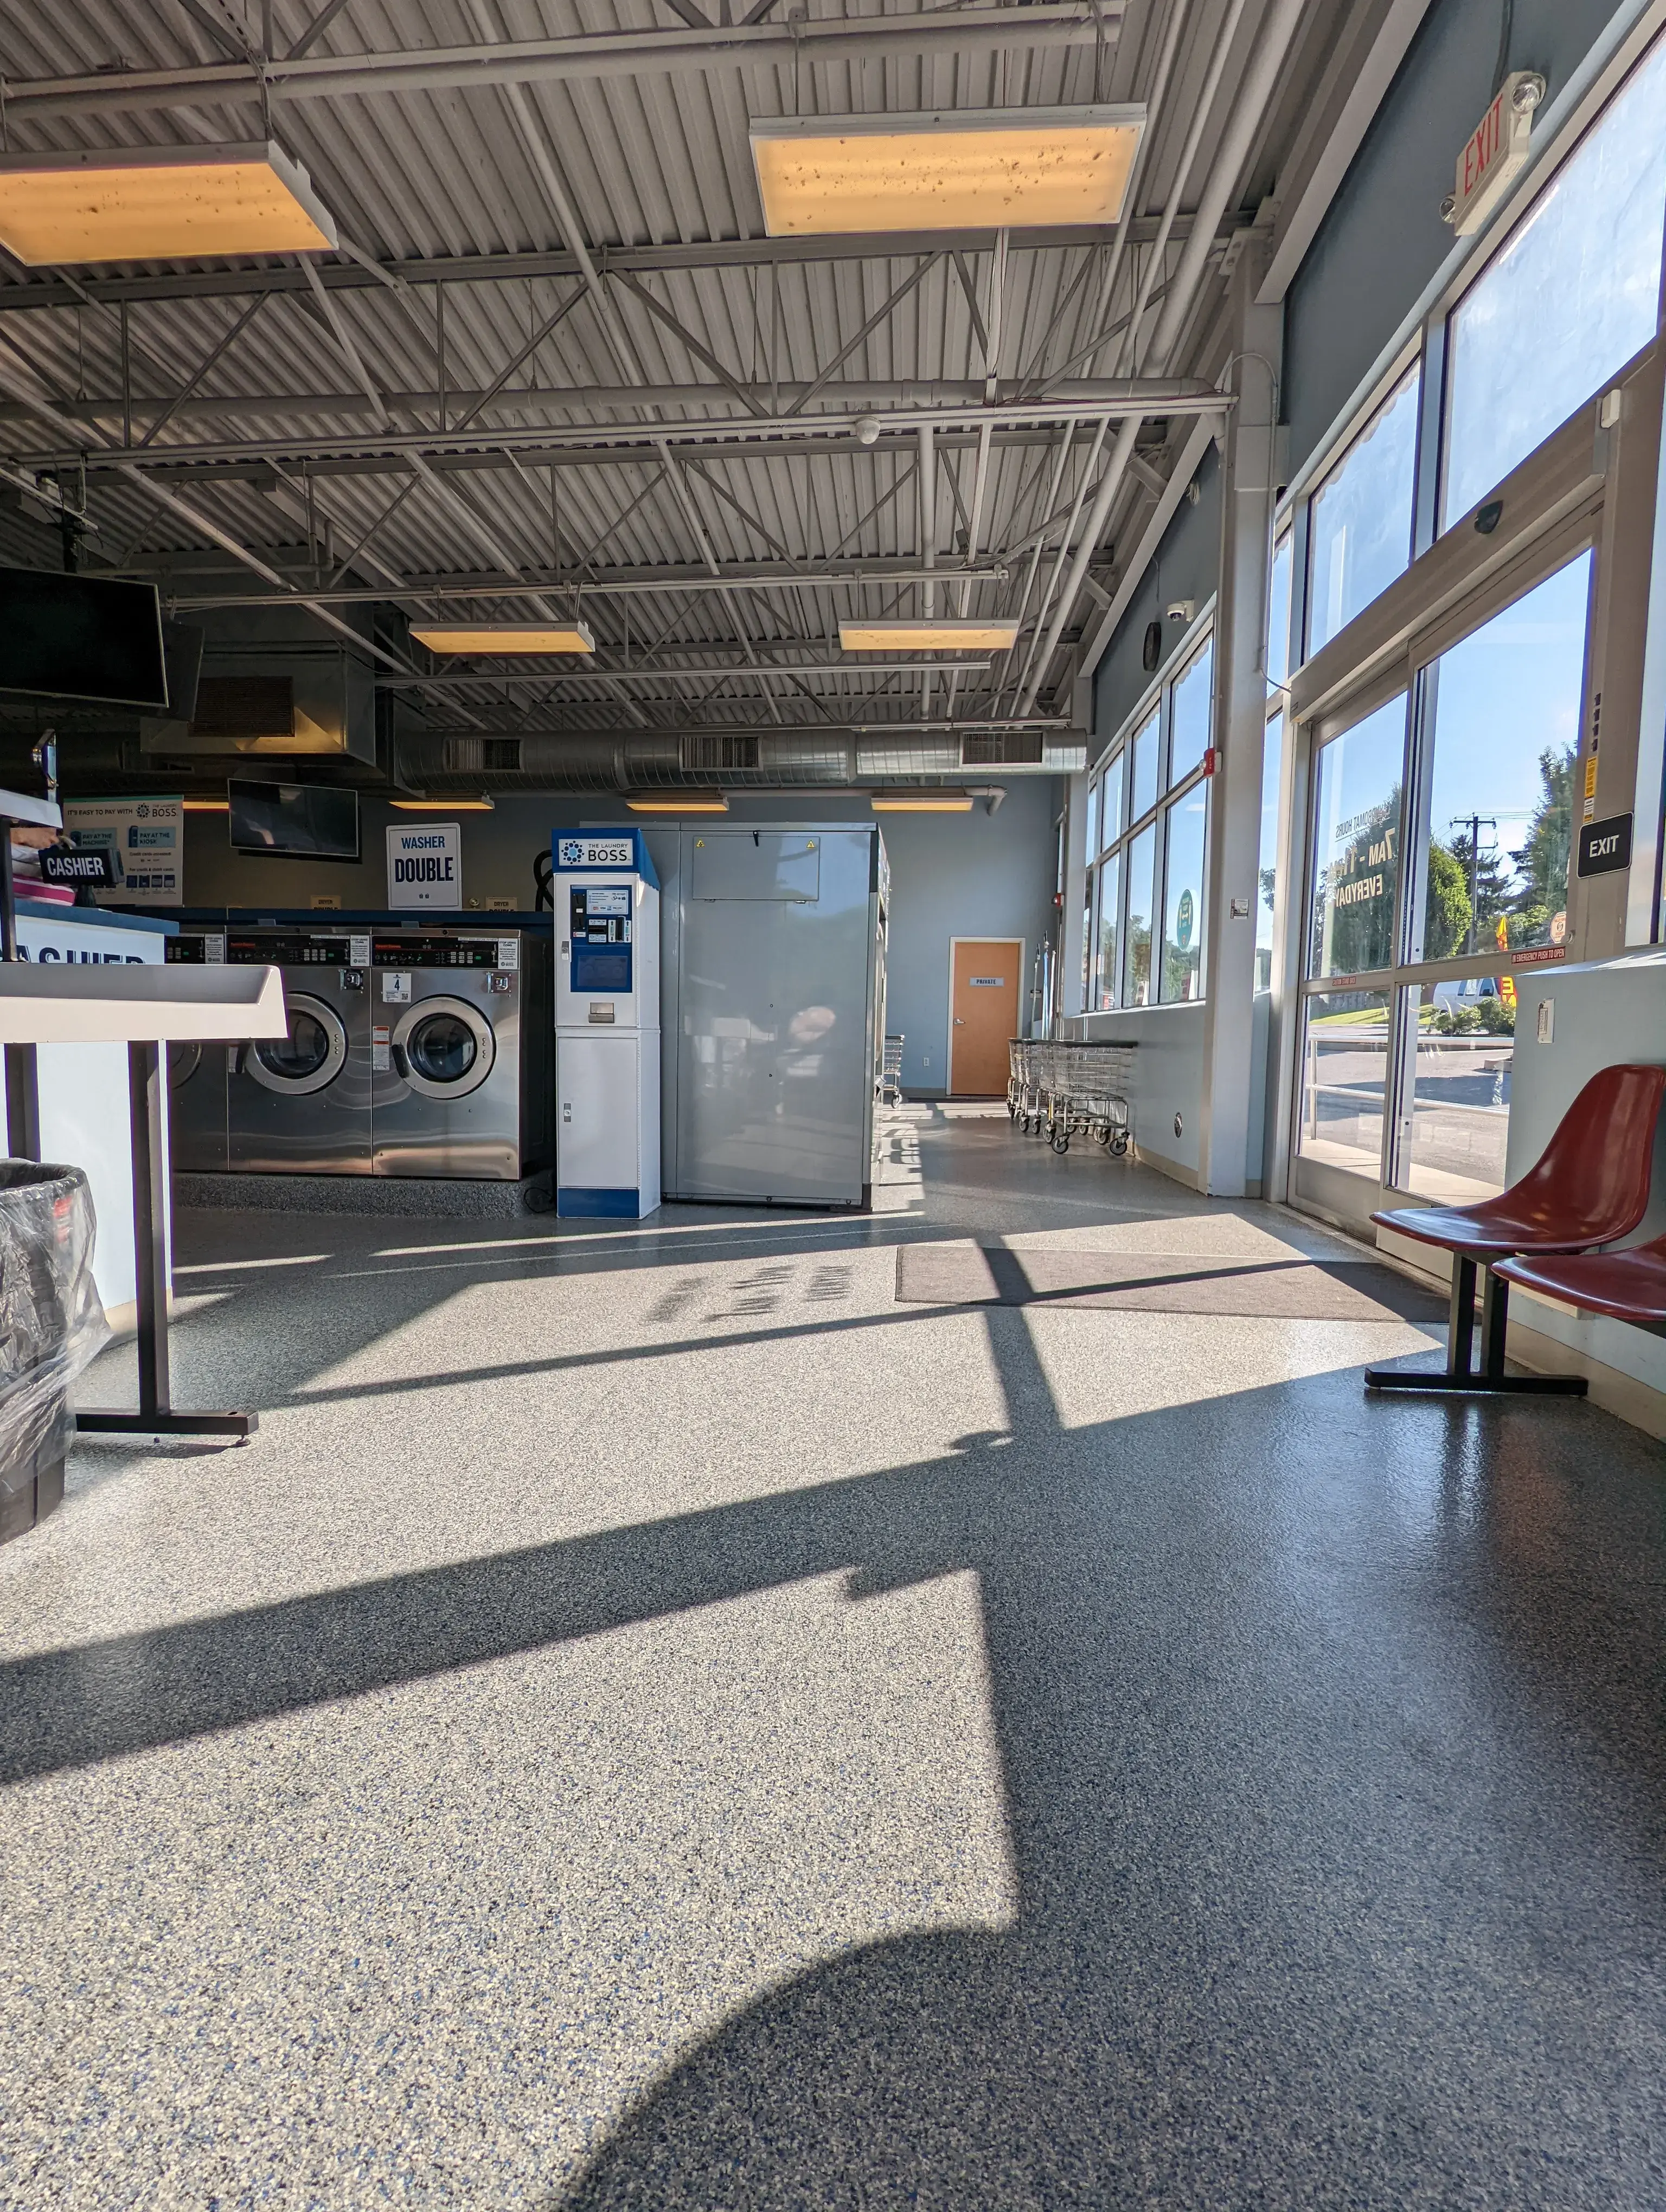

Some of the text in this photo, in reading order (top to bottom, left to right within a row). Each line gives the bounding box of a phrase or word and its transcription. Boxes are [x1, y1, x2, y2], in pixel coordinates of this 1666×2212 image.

[1465, 93, 1503, 197] EXIT
[152, 808, 176, 817] BOSS
[401, 836, 445, 849] WASHER
[1589, 834, 1619, 858] EXIT
[588, 850, 627, 861] BOSS
[47, 857, 105, 876] CASHIER
[395, 857, 454, 883] DOUBLE
[1516, 951, 1537, 962] EMERGENCY
[1537, 950, 1548, 960] PUSH
[1548, 949, 1554, 959] TO
[1554, 948, 1565, 958] OPEN
[394, 979, 400, 991] 4
